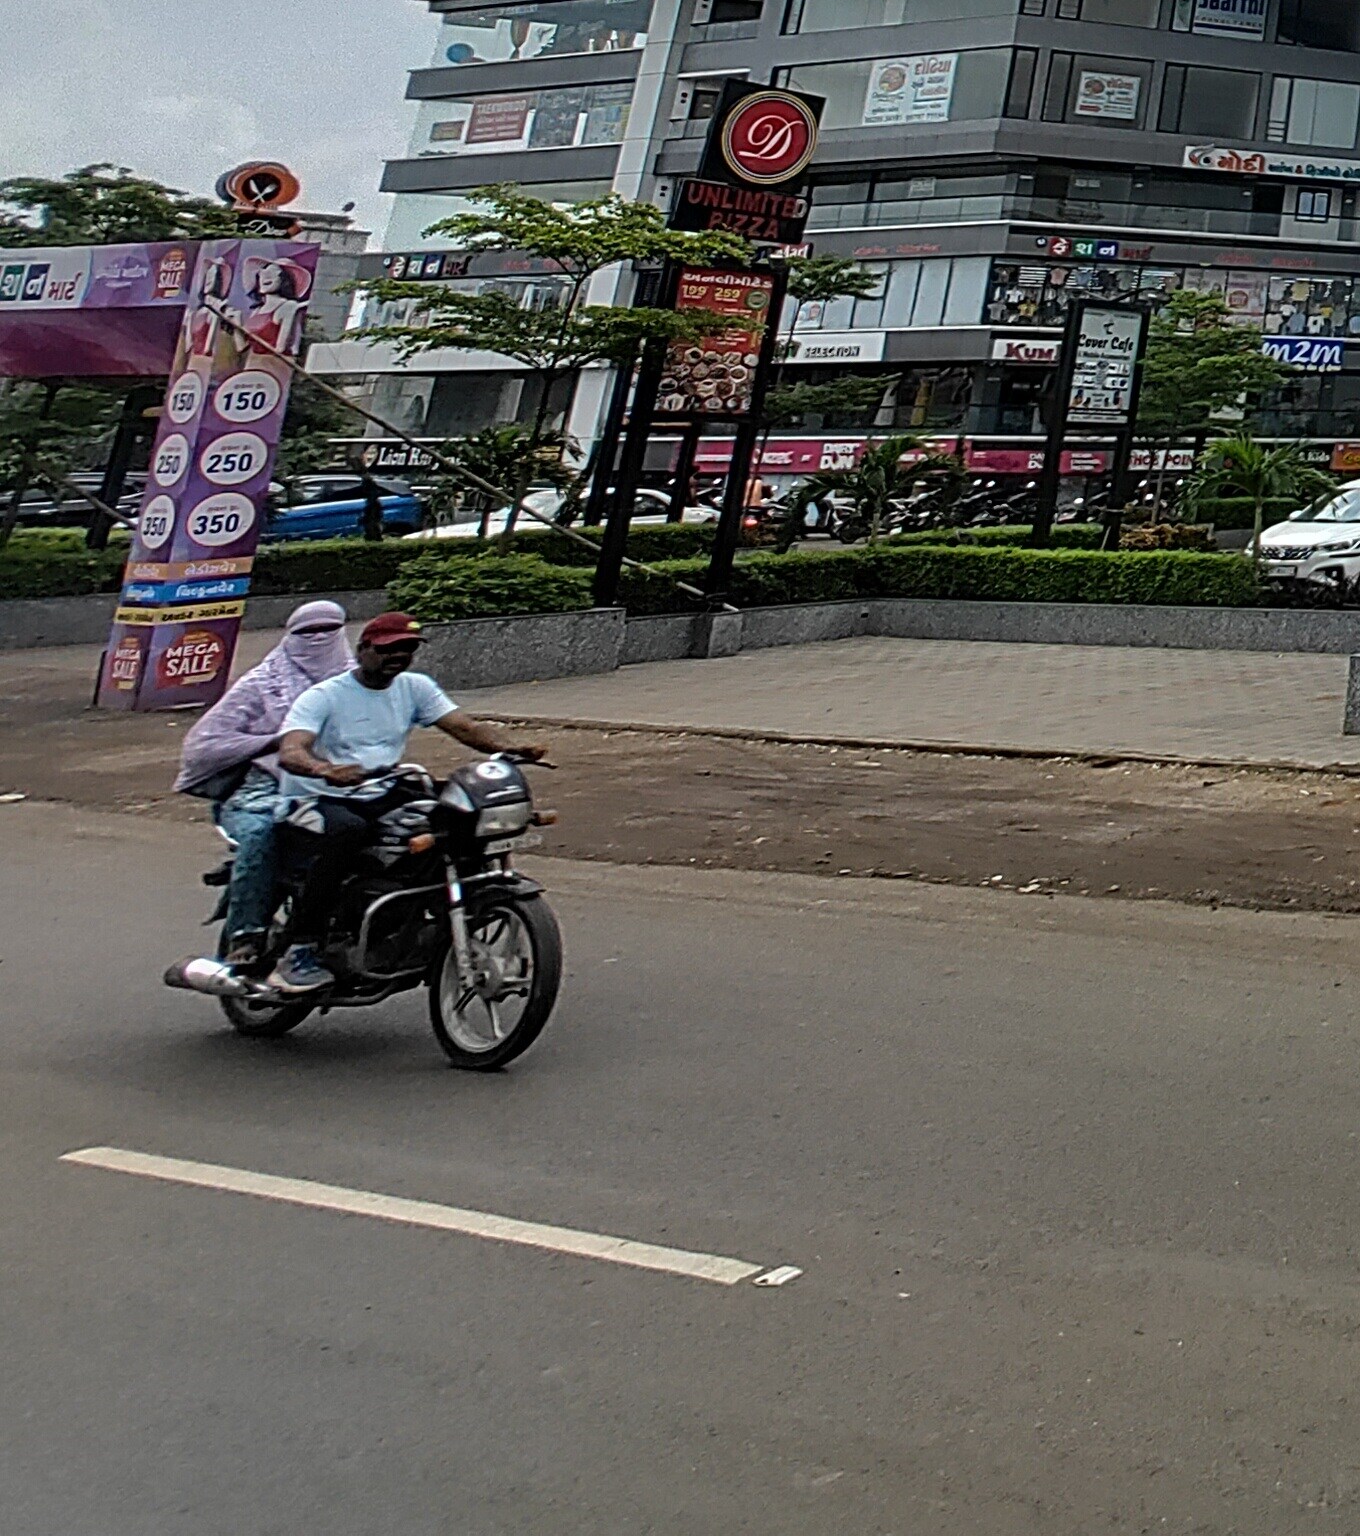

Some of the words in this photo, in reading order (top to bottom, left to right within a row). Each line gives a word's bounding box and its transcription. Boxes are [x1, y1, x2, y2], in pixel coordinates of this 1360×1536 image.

[1217, 149, 1266, 173] મોદી
[687, 182, 809, 219] UNLIMITED
[709, 211, 779, 240] PIZZA
[160, 260, 185, 271] MEGA
[158, 271, 183, 289] SALE
[804, 344, 860, 359] SELECTION
[1077, 332, 1108, 350] Cover
[1110, 335, 1135, 353] Cafe
[1261, 340, 1342, 364] m2m
[171, 392, 195, 412] 150
[223, 391, 267, 412] 150
[155, 454, 181, 475] 250
[206, 452, 254, 475] 250
[142, 516, 167, 537] 350
[192, 513, 240, 536] 350
[165, 642, 220, 659] MEGA
[112, 660, 138, 679] SALE
[165, 654, 215, 677] SALE
